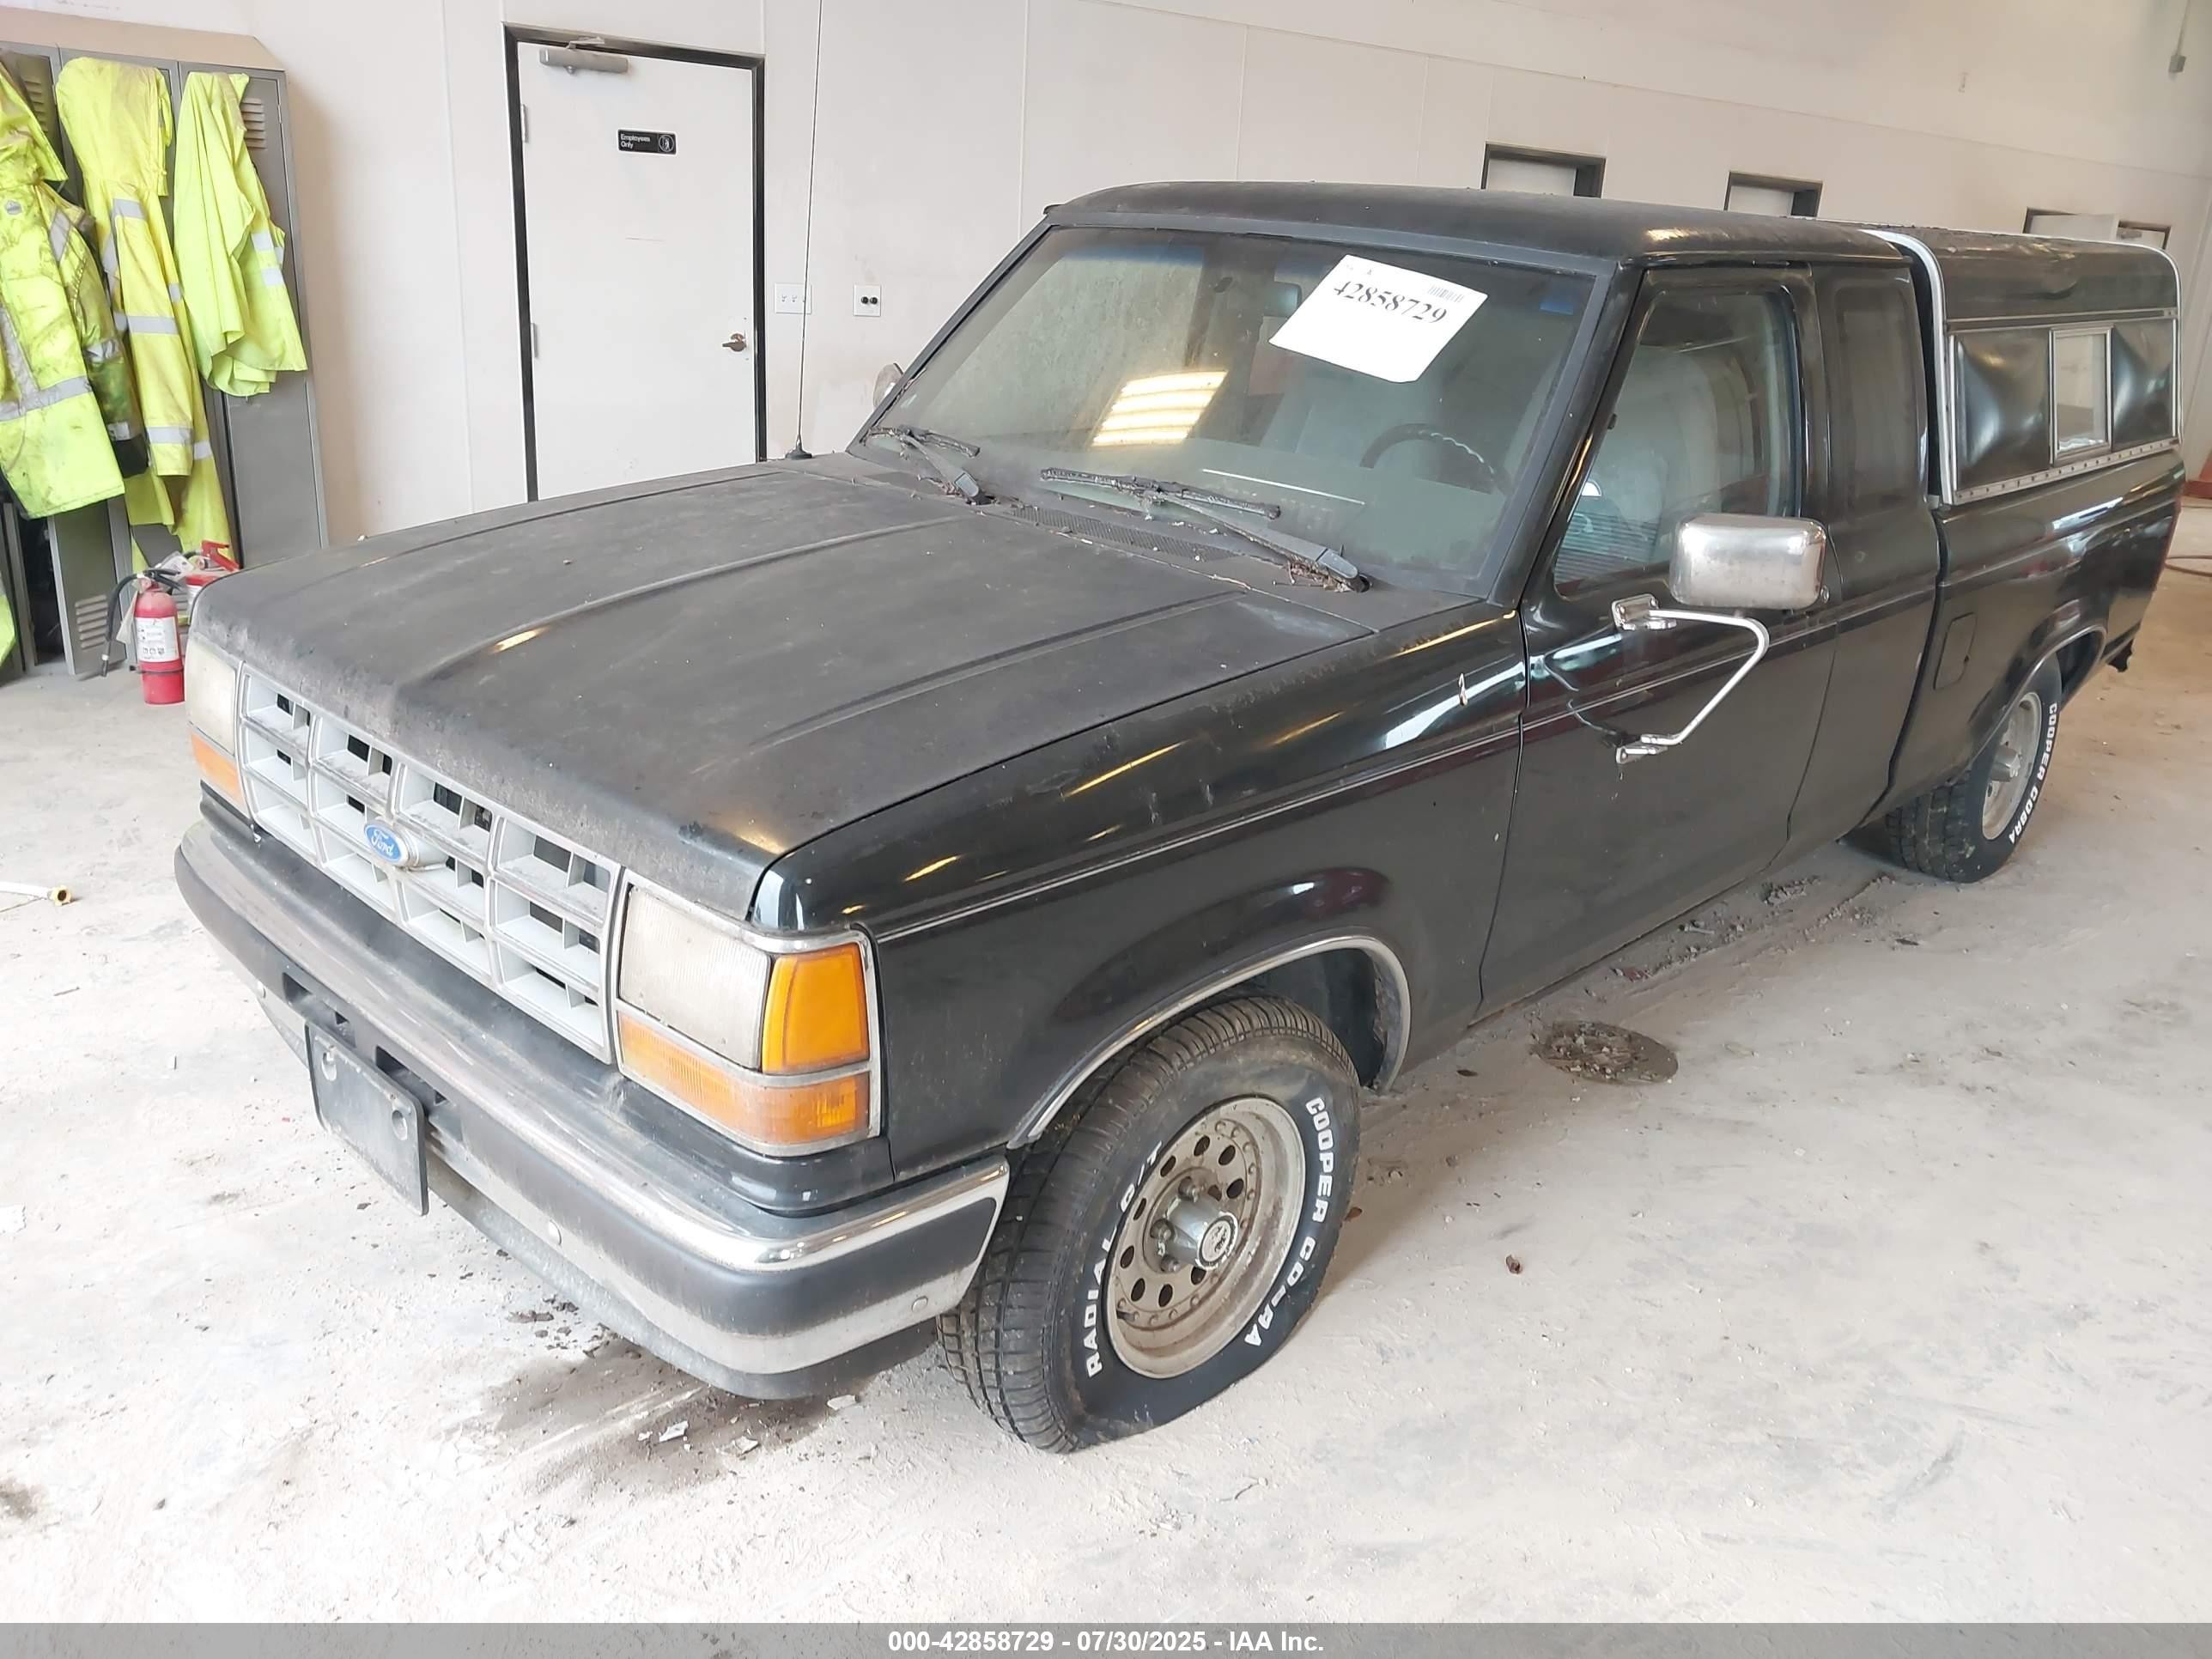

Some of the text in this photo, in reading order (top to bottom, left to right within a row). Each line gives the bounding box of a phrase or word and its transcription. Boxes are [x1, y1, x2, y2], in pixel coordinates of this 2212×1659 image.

[621, 134, 650, 143] Employees
[1334, 281, 1447, 324] 42858729
[2008, 703, 2057, 844] COOPER COBRA
[371, 829, 395, 857] Ford
[1305, 1097, 1334, 1223] COOPER
